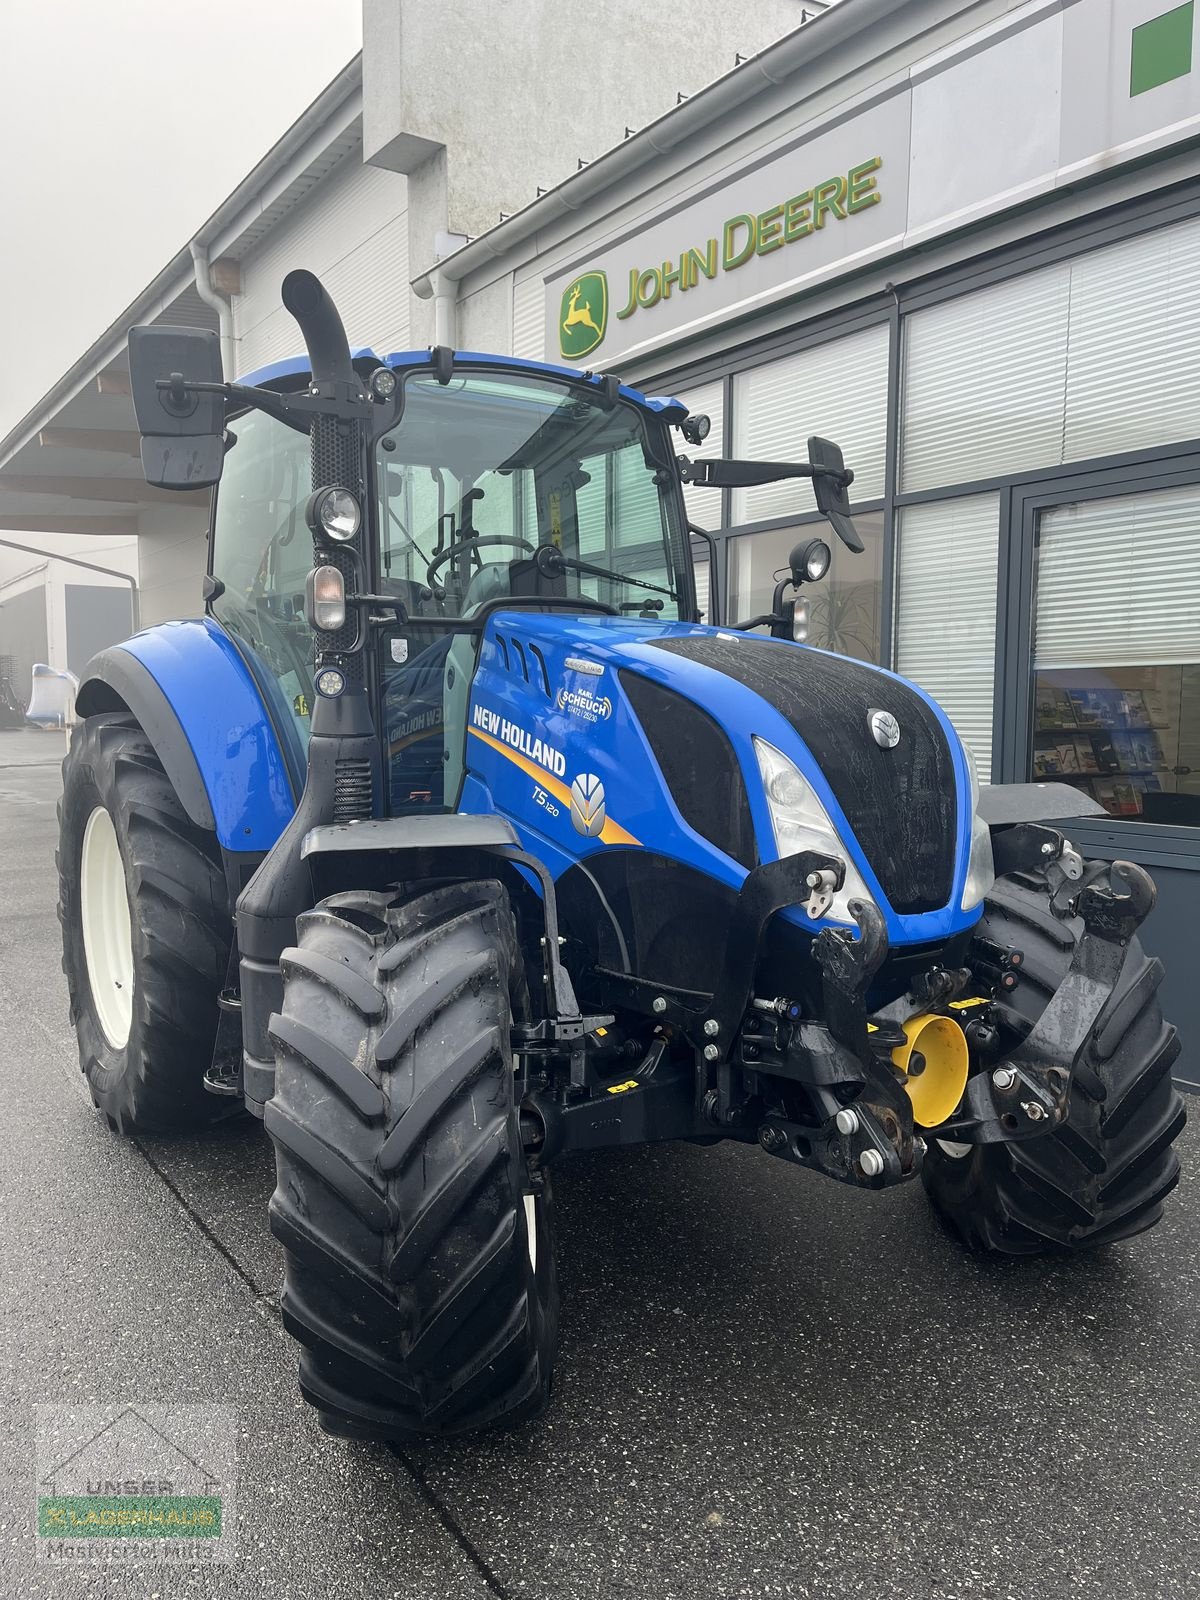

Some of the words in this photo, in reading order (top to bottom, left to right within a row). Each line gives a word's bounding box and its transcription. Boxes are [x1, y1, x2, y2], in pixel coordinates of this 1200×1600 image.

[616, 238, 718, 320] JOHN
[722, 156, 882, 272] DEERE
[562, 690, 607, 717] SCHEUCH
[577, 688, 594, 700] KARL
[473, 703, 499, 736] NEW
[501, 718, 566, 777] HOLLAND
